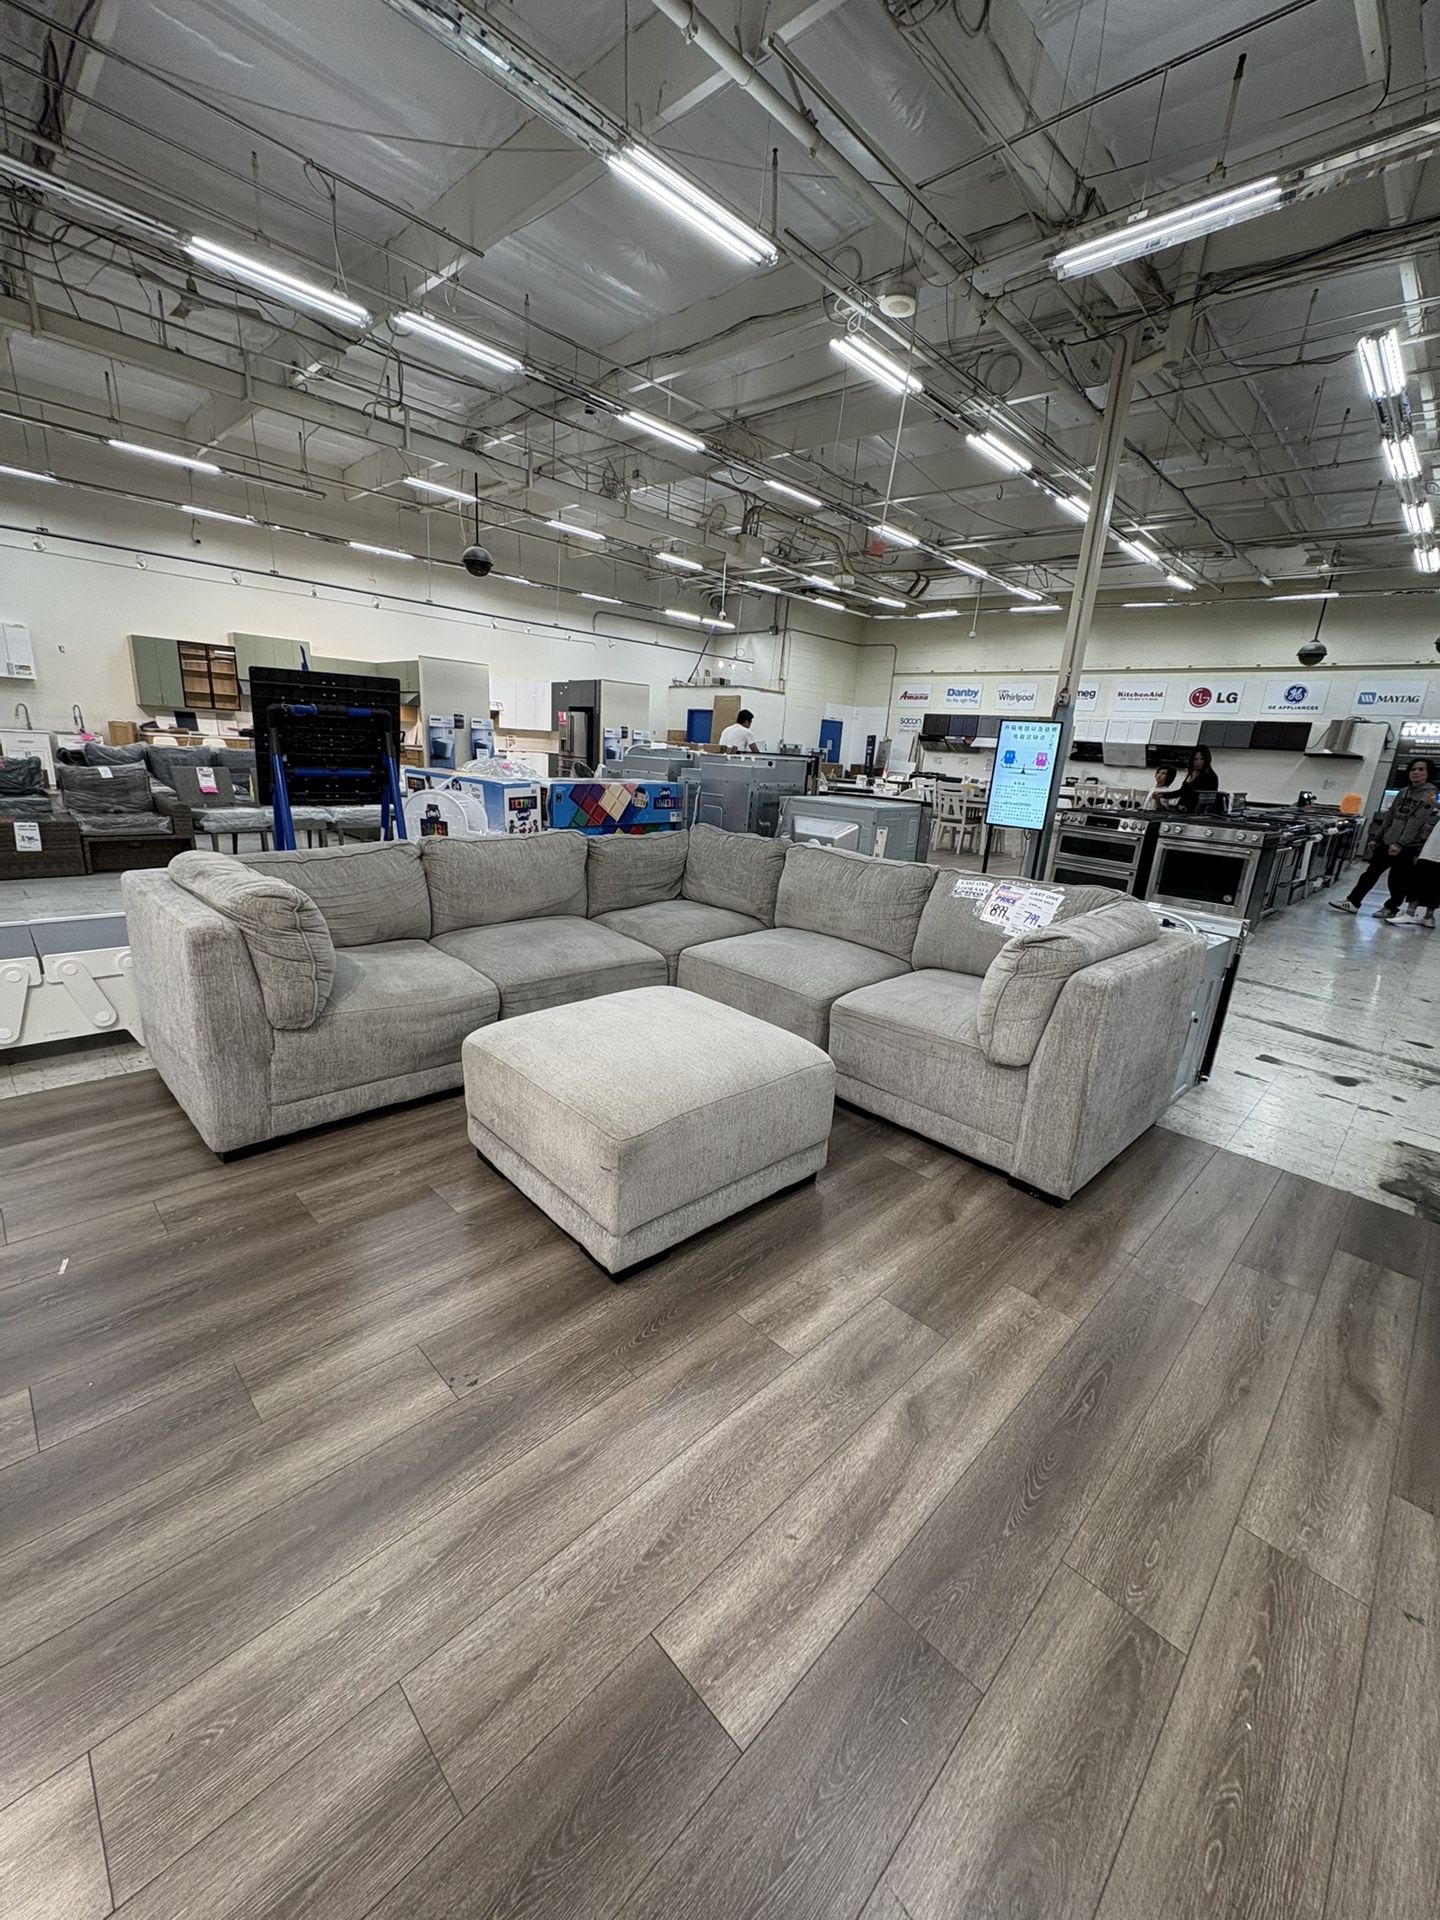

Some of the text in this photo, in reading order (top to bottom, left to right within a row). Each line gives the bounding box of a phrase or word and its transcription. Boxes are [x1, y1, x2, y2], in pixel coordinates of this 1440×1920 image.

[899, 690, 929, 700] Amana
[947, 688, 980, 698] Danby
[998, 692, 1034, 703] Whirlpool
[1076, 690, 1096, 699] meg
[1216, 692, 1238, 704] LG
[1376, 695, 1420, 703] MAYTAG
[511, 798, 536, 809] TETRIS
[995, 896, 1016, 905] PRICE
